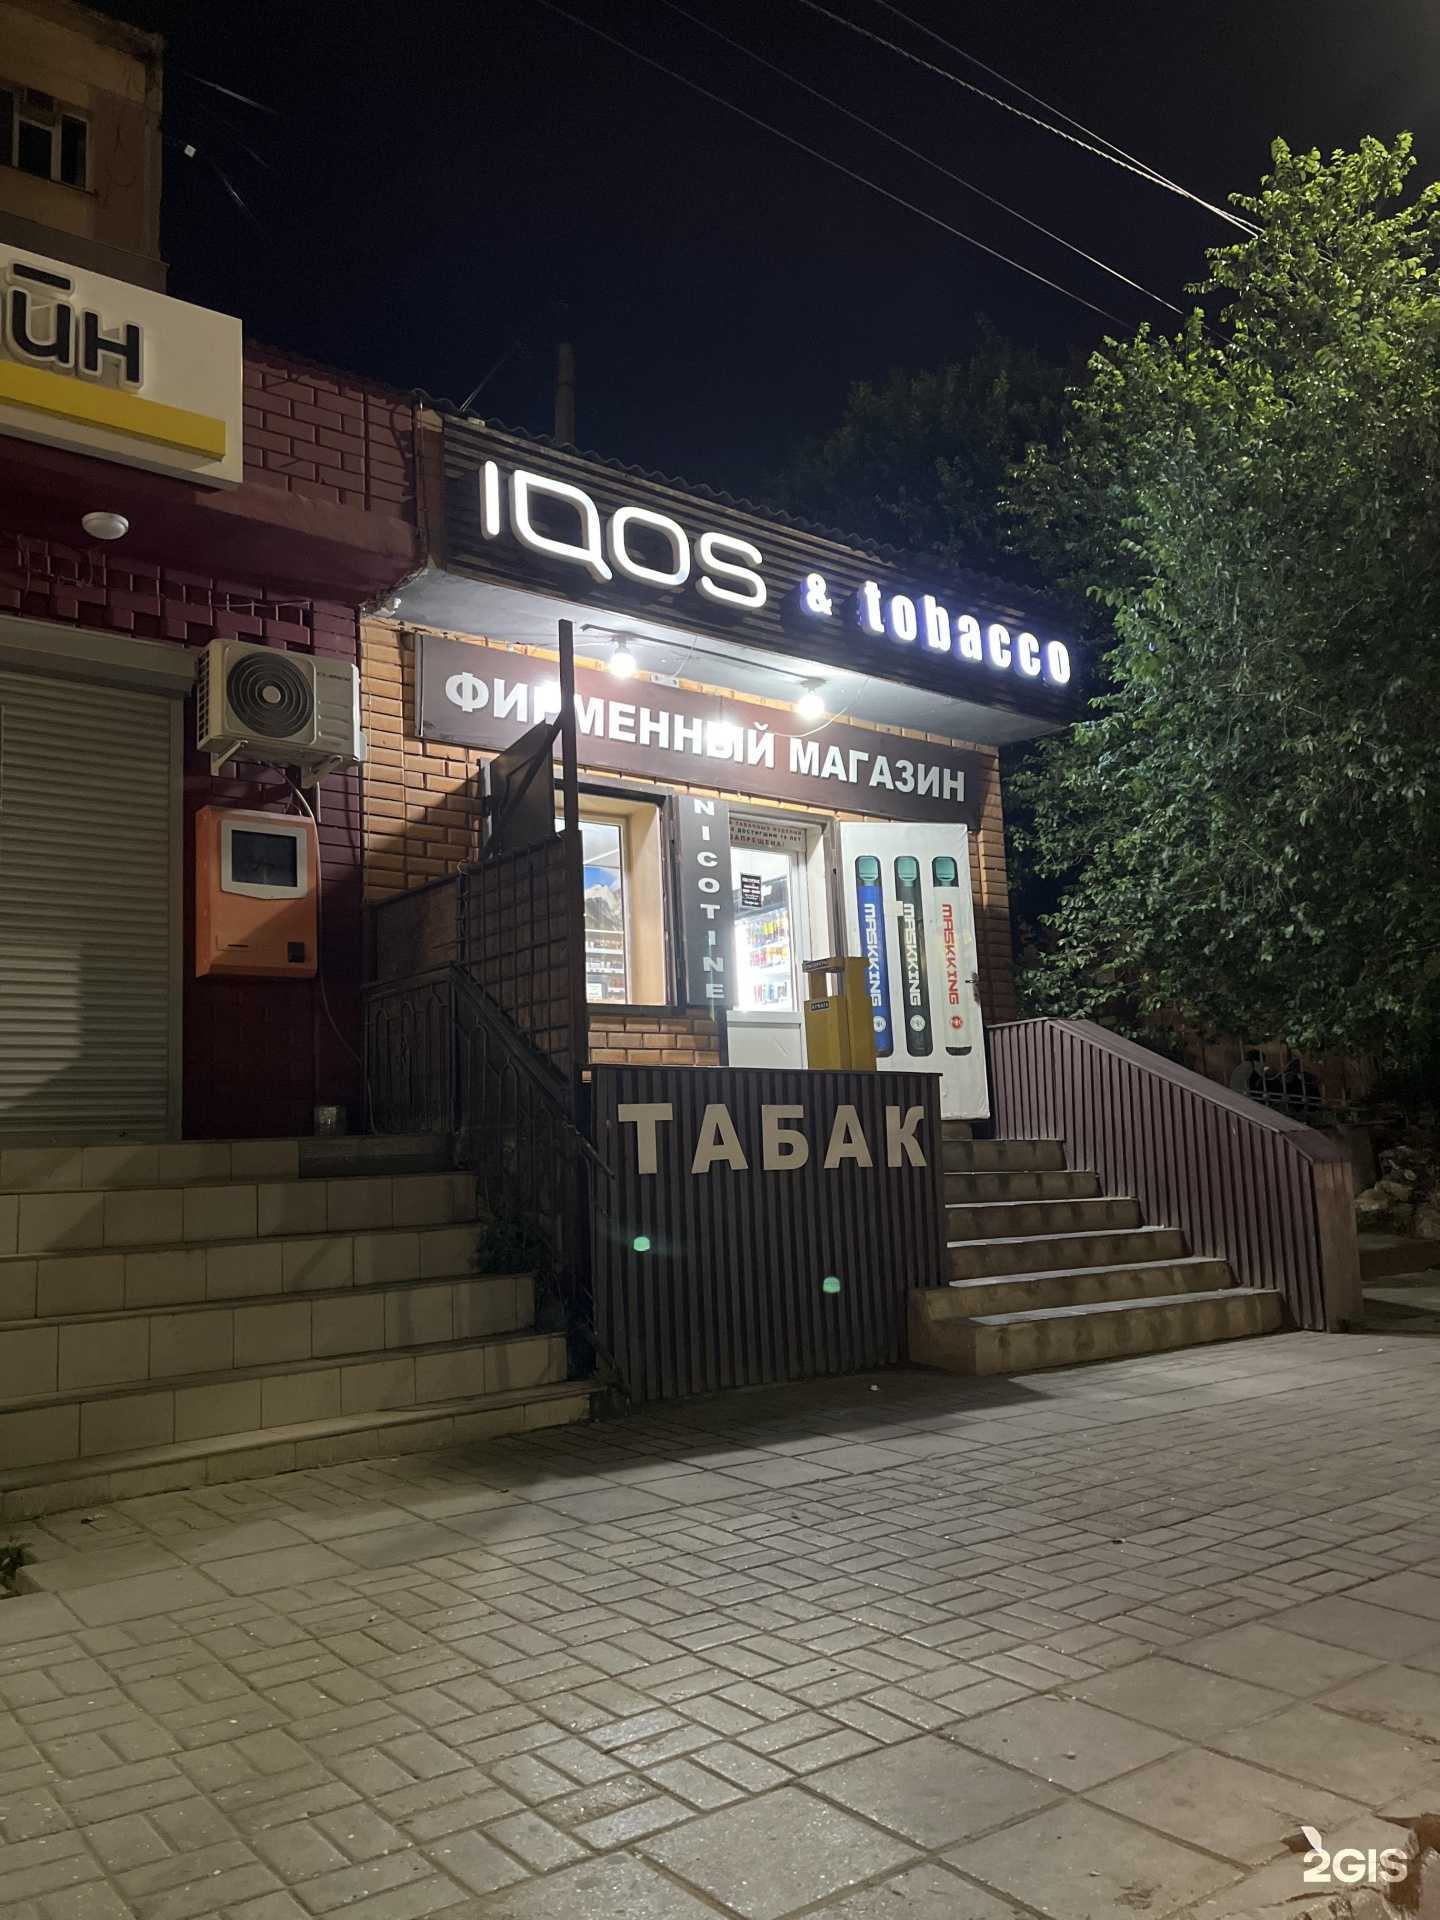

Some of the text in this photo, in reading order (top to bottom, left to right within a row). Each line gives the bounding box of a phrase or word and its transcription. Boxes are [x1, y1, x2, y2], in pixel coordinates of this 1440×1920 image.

[480, 459, 1072, 684] IQOS & tobacco
[789, 736, 965, 802] МАГАЗИН
[693, 799, 726, 999] NICOTINE
[617, 1102, 928, 1175] ТАБАК
